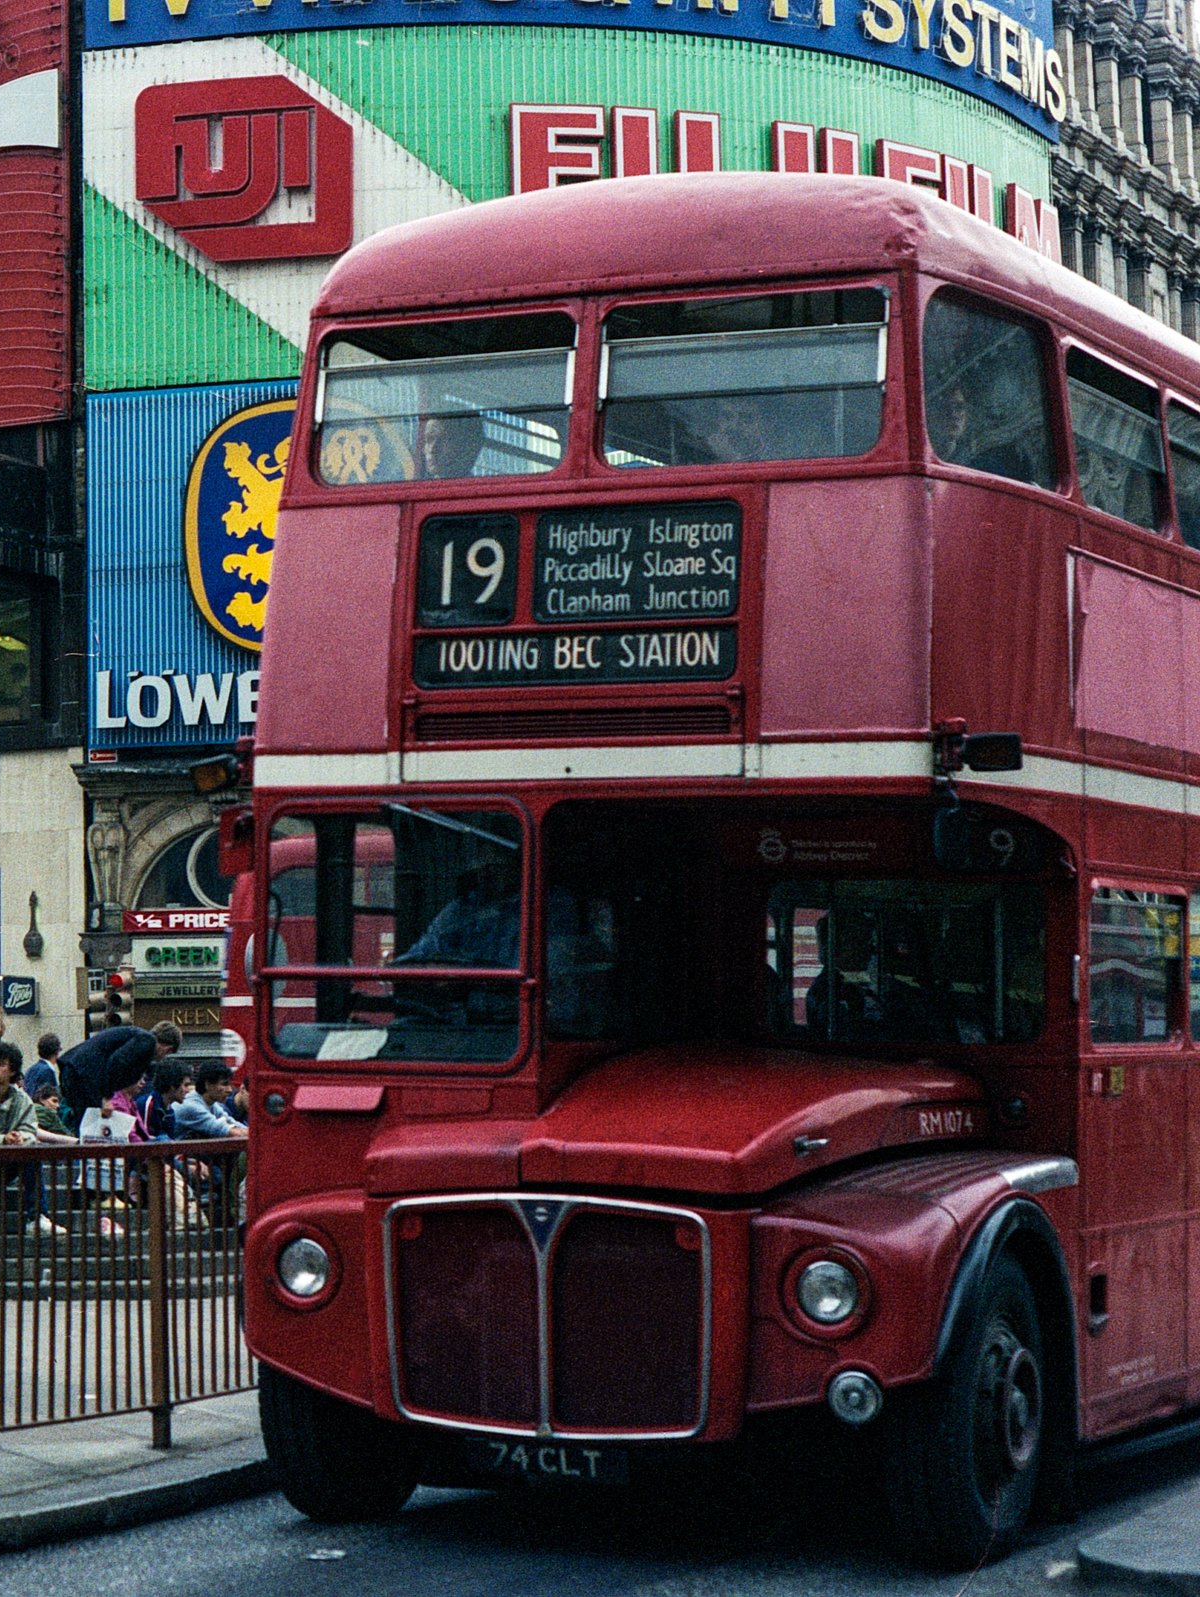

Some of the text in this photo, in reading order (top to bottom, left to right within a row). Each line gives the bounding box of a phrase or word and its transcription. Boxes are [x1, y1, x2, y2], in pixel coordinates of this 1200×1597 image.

[863, 0, 1067, 122] SYSTEMS
[549, 518, 734, 555] Highbury Islington
[440, 536, 507, 607] 19
[544, 548, 737, 586] Piccadilly Sloane Sq
[546, 584, 730, 615] Clapham Junction
[554, 635, 601, 669] BEC
[619, 631, 720, 668] STATION
[169, 912, 231, 929] PRICE
[145, 945, 220, 966] GREEN
[159, 985, 221, 998] JEWELLERY
[919, 1109, 974, 1135] RM1074
[538, 1447, 601, 1479] CLT
